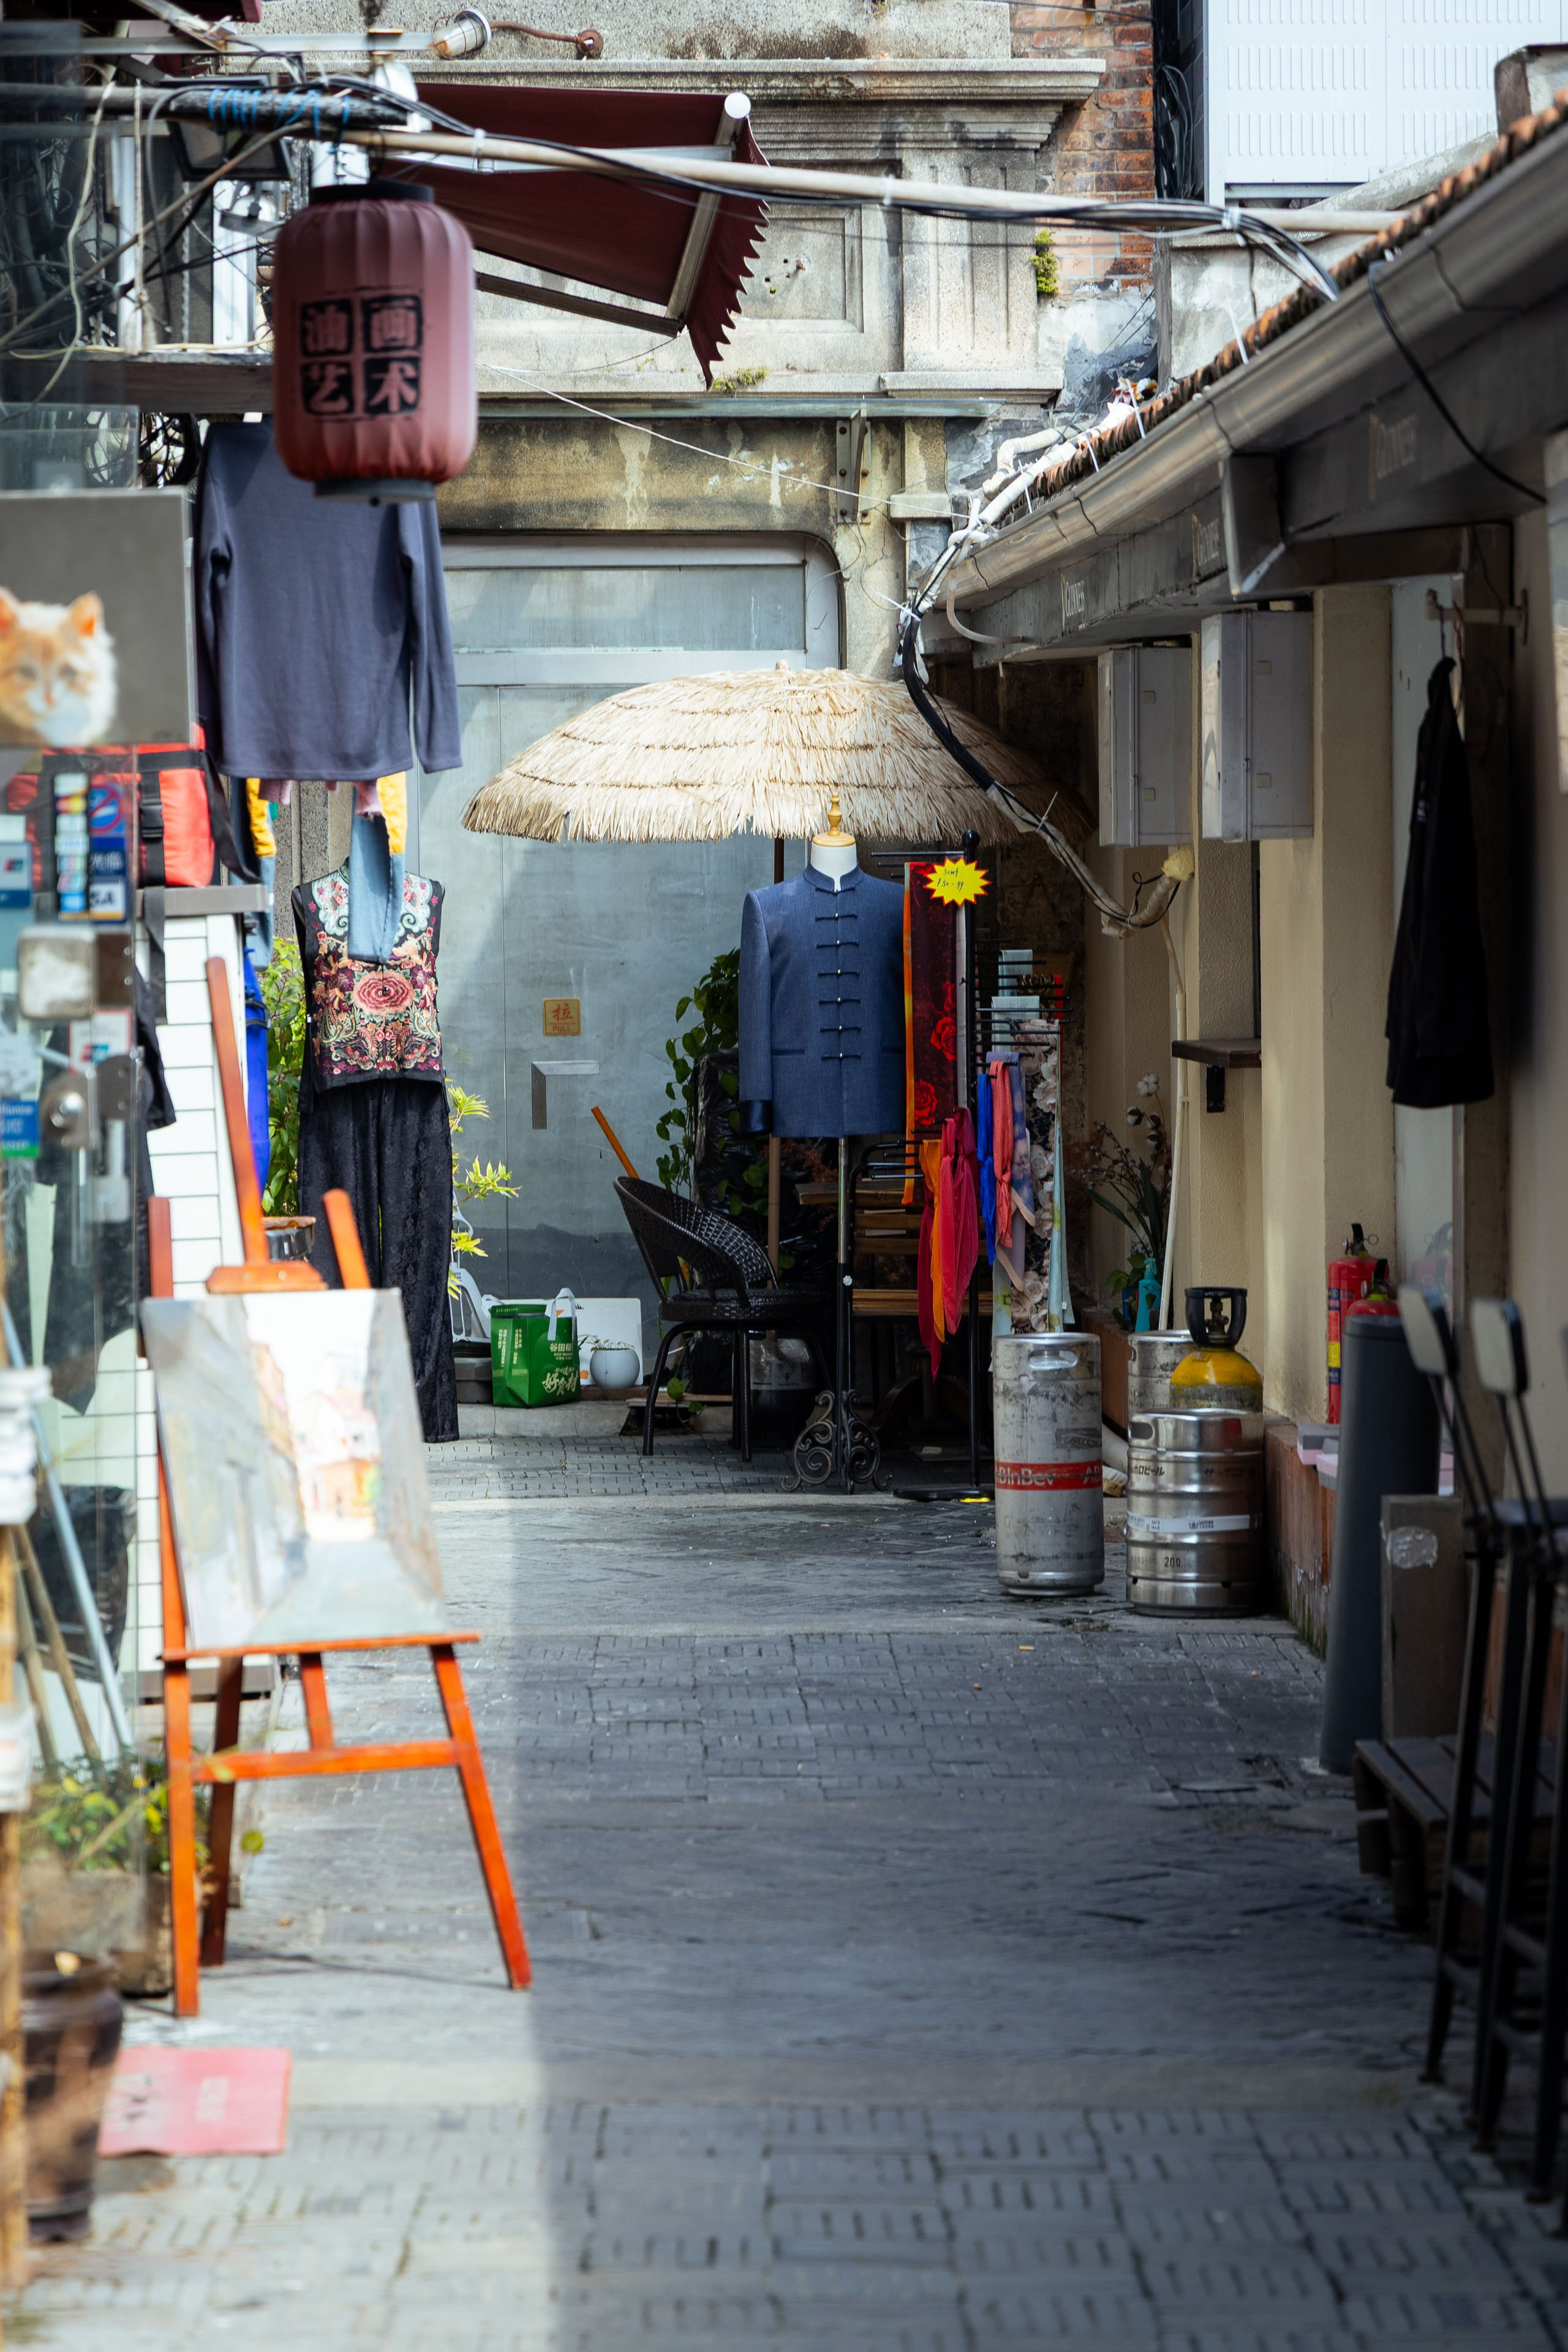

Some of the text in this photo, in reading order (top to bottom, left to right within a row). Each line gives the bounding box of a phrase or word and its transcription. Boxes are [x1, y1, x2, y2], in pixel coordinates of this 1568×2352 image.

[306, 299, 418, 351] 油画
[309, 361, 418, 412] 艺术
[552, 1003, 573, 1022] 拉
[542, 1371, 578, 1395] 好食材
